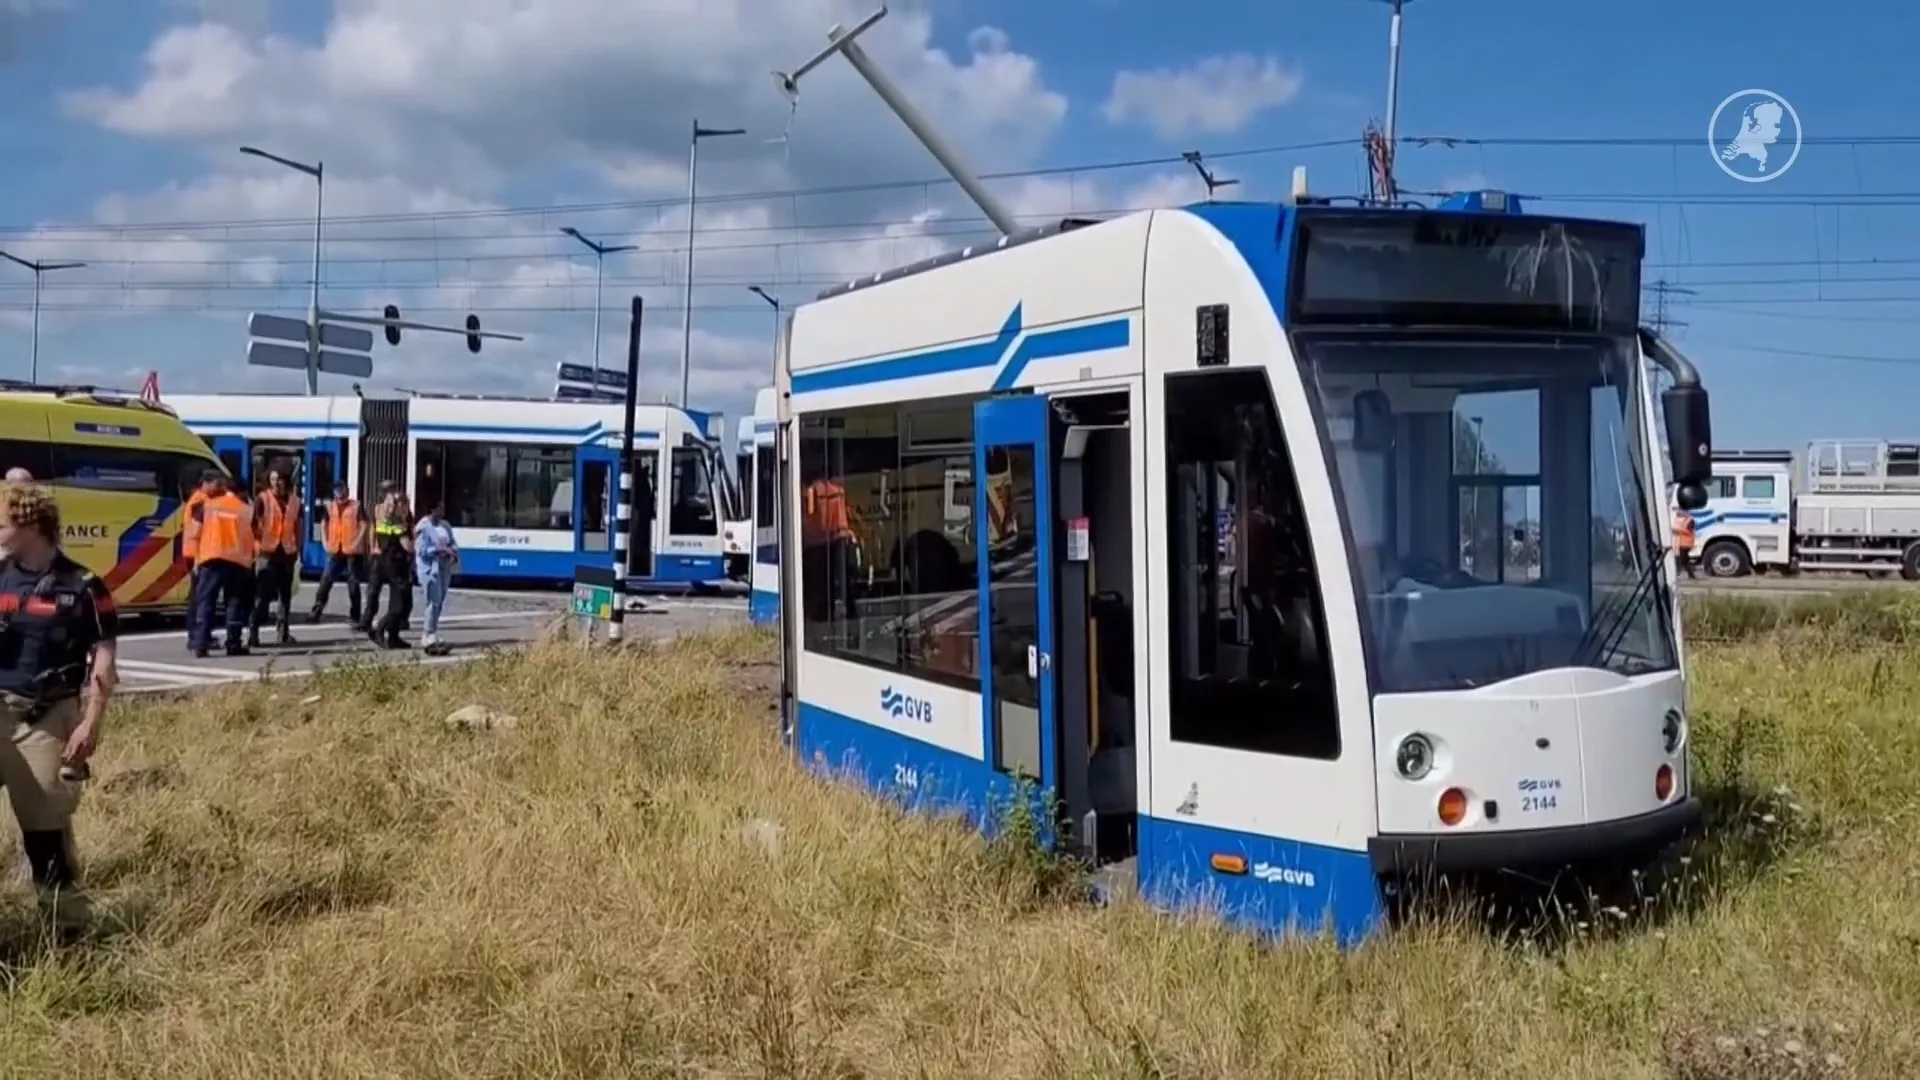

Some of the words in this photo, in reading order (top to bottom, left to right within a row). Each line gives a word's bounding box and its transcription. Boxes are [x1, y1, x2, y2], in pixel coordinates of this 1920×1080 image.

[904, 695, 932, 723] GVB
[895, 763, 918, 789] 2144
[1540, 780, 1561, 789] GVB
[1521, 796, 1557, 811] 2144
[1283, 868, 1315, 887] GVB
